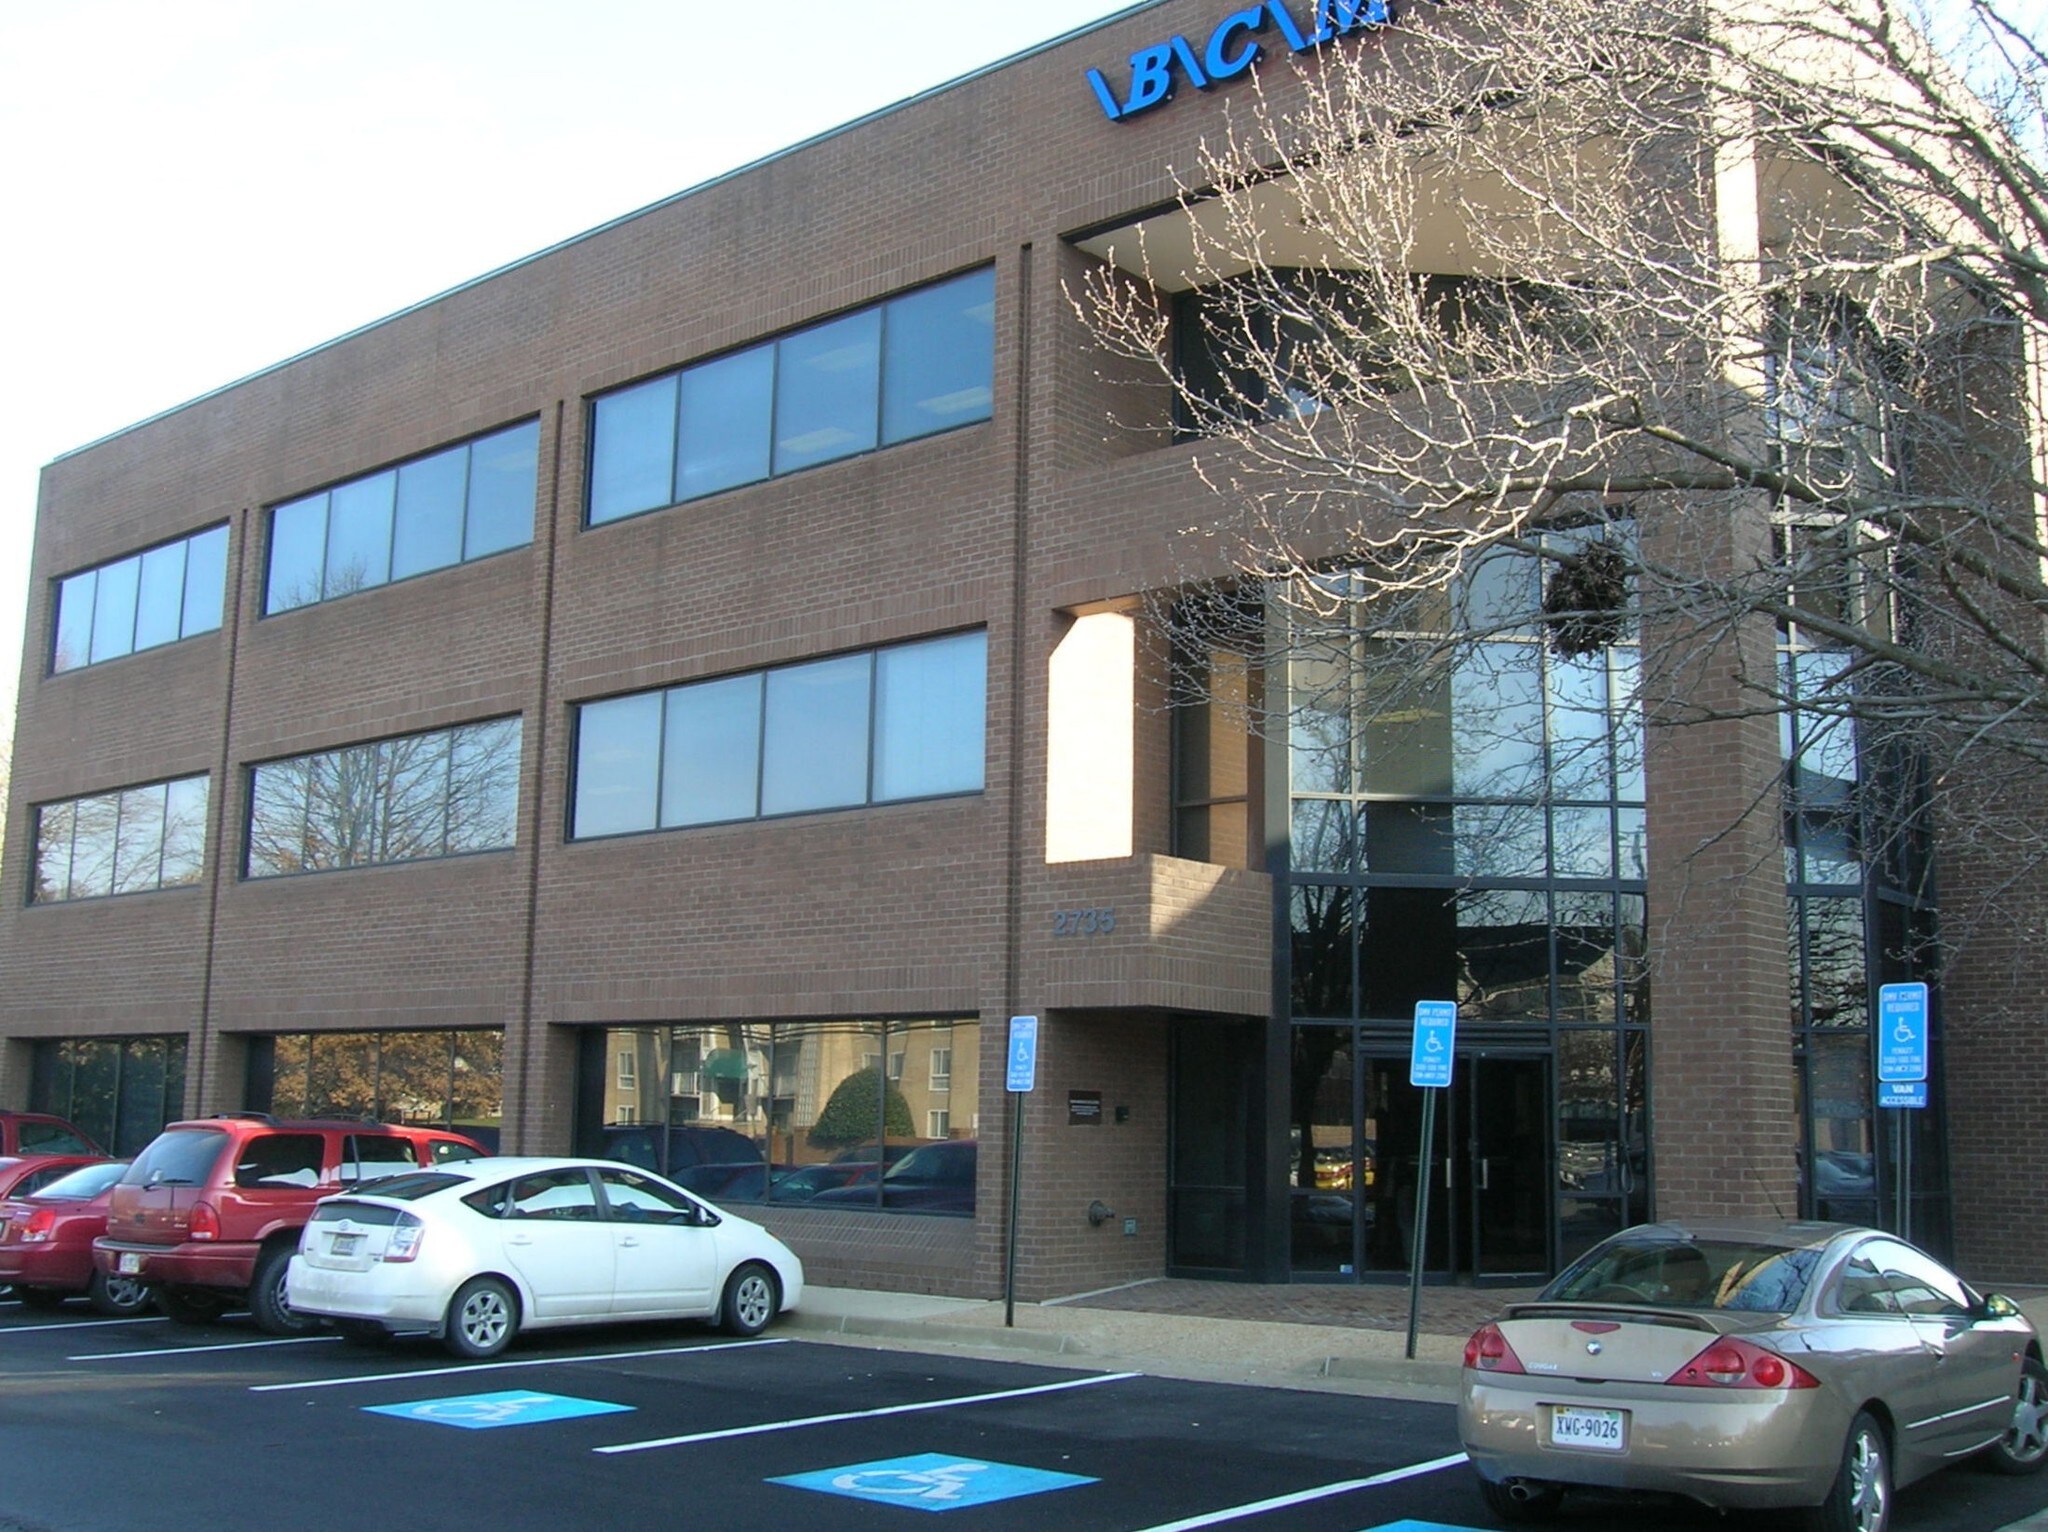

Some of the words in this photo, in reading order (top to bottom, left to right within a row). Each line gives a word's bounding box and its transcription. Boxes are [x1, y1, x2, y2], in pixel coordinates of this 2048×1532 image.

[1053, 907, 1115, 935] 2735
[1892, 1084, 1914, 1094] VAN
[1881, 1095, 1924, 1105] ACCESSIBLE
[1556, 1415, 1619, 1438] XWG-9026
